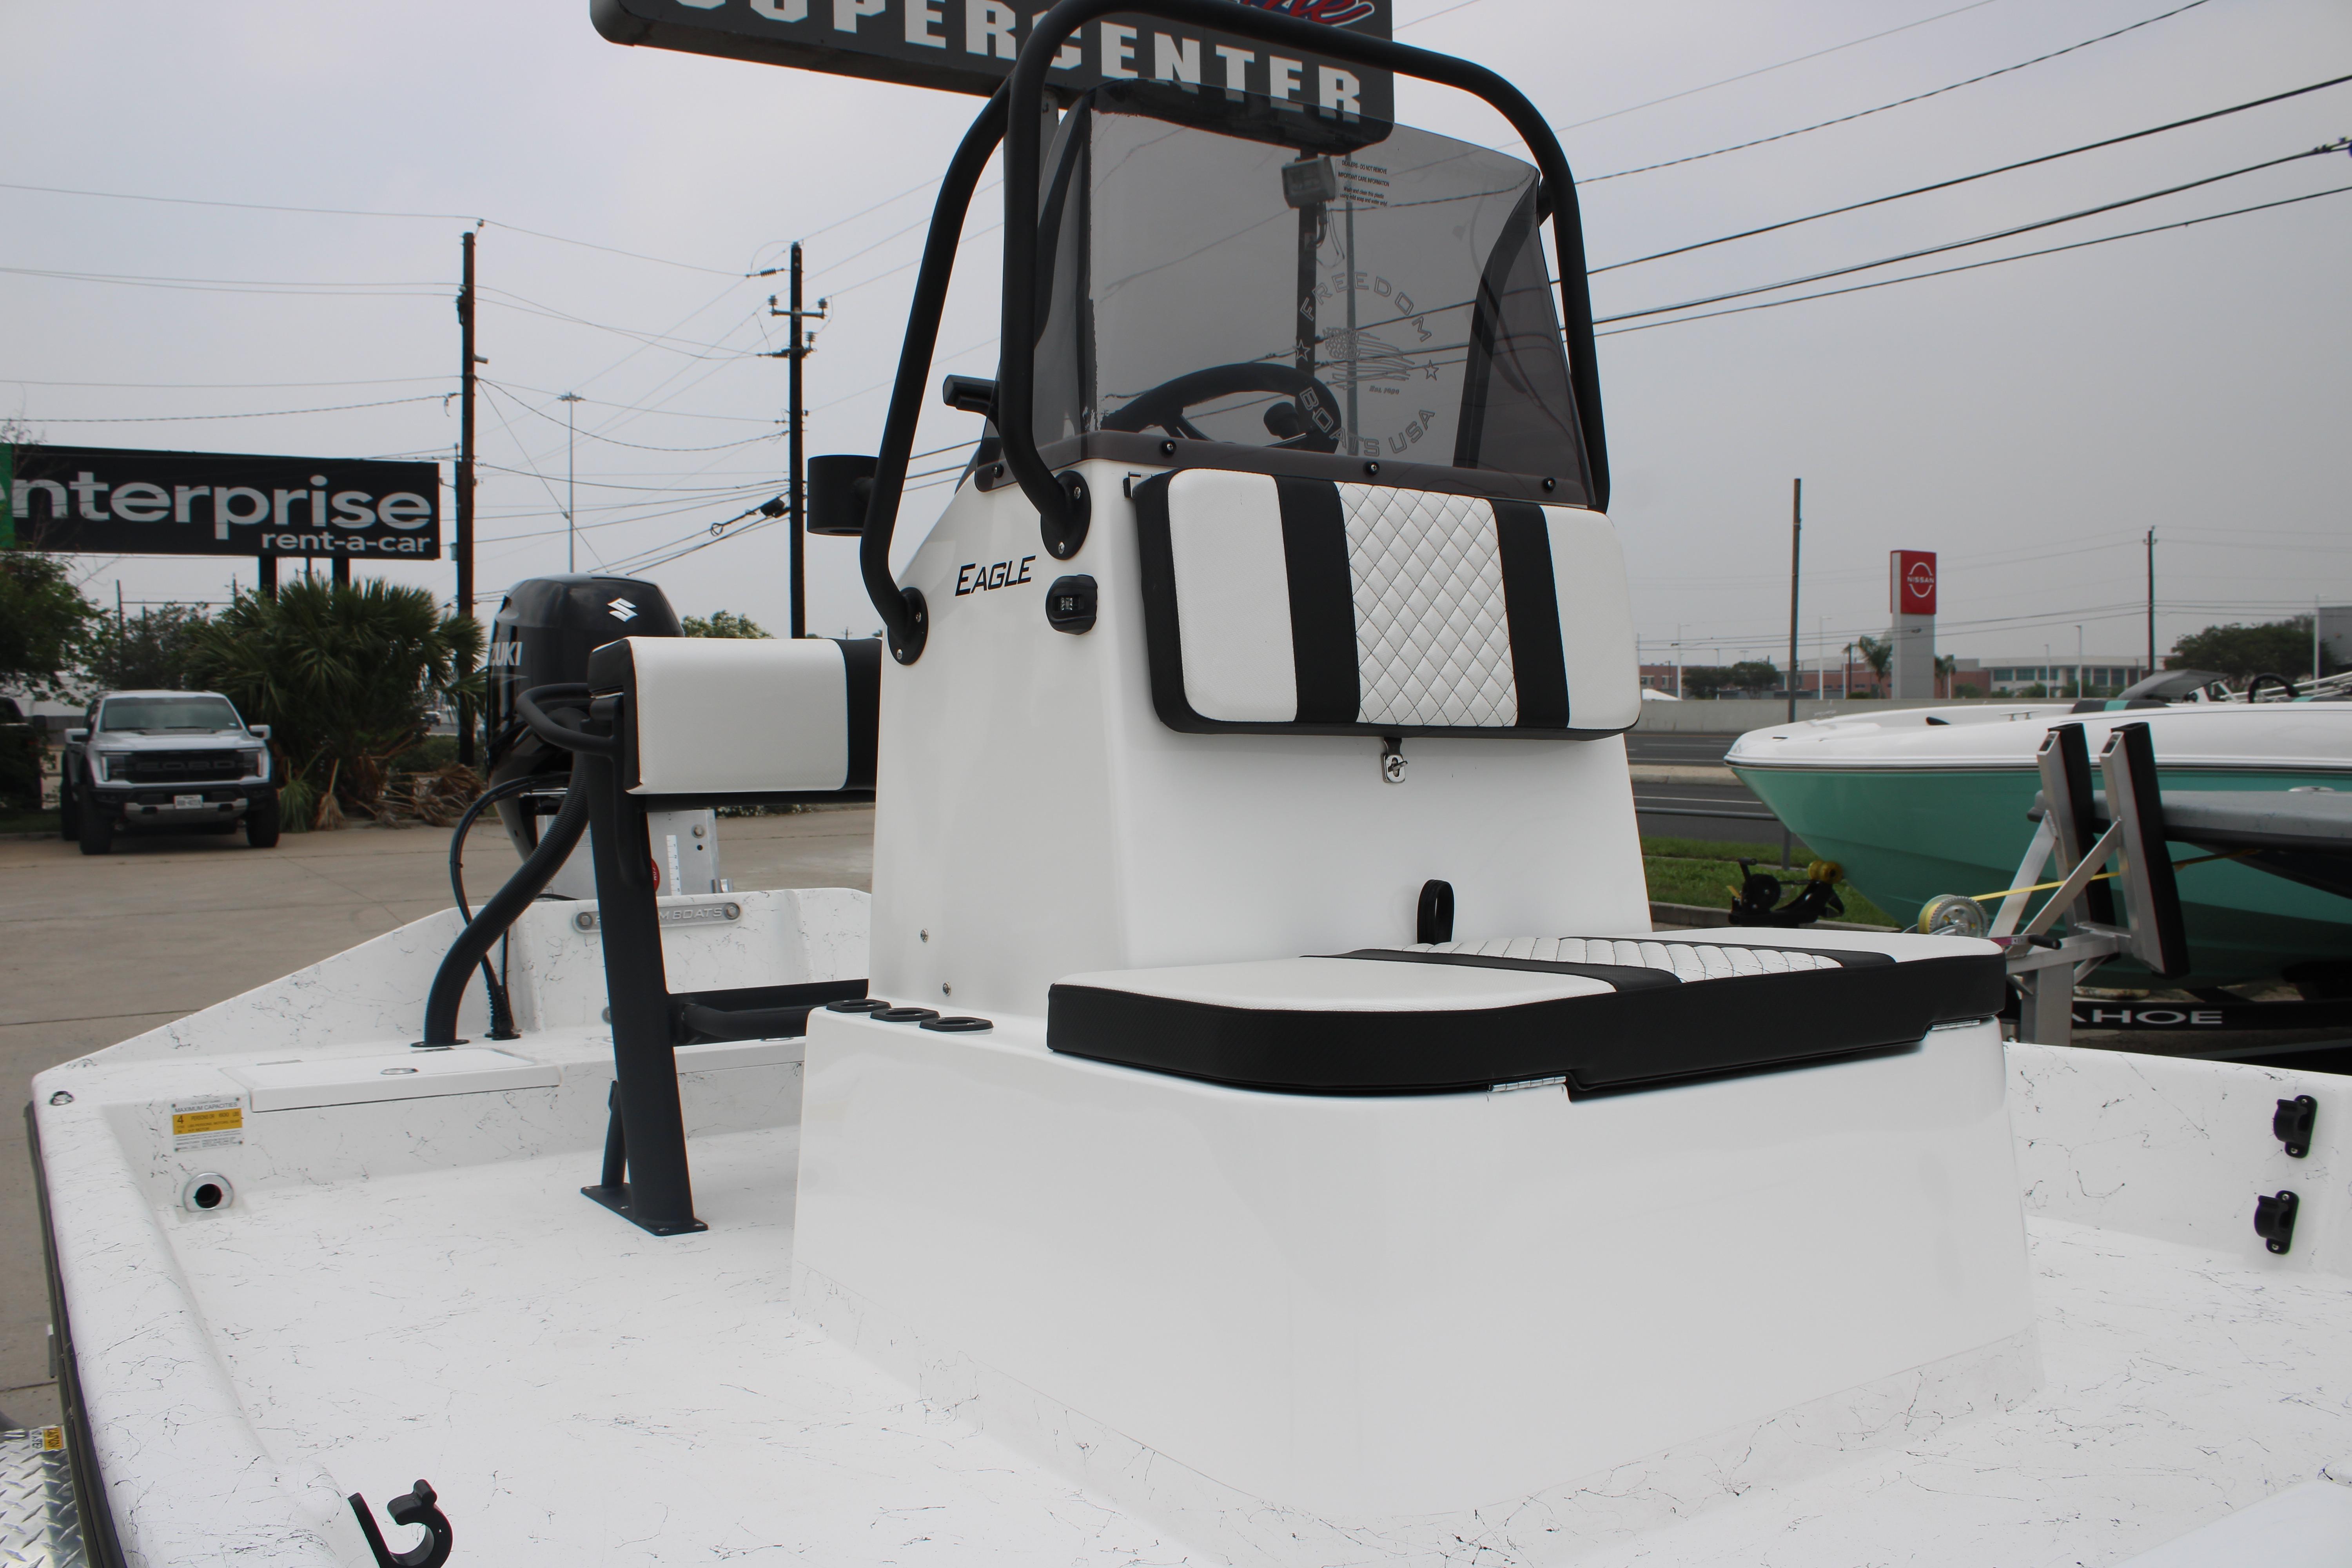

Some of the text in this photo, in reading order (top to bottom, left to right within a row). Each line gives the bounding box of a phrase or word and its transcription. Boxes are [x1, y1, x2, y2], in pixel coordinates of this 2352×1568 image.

[675, 0, 1361, 123] PERENTER
[1342, 160, 1358, 169] DEALERS
[1338, 171, 1357, 180] IMPORTANT
[1367, 178, 1390, 187] INFORMATION
[1300, 272, 1432, 342] FREEDOM
[1299, 387, 1436, 457] BOATS USA
[0, 471, 432, 539] nterprise
[261, 532, 430, 552] rent-a-car
[955, 555, 1036, 596] EAGLE
[137, 760, 235, 772] FORD
[673, 907, 722, 920] BOATS
[177, 1115, 184, 1124] 4
